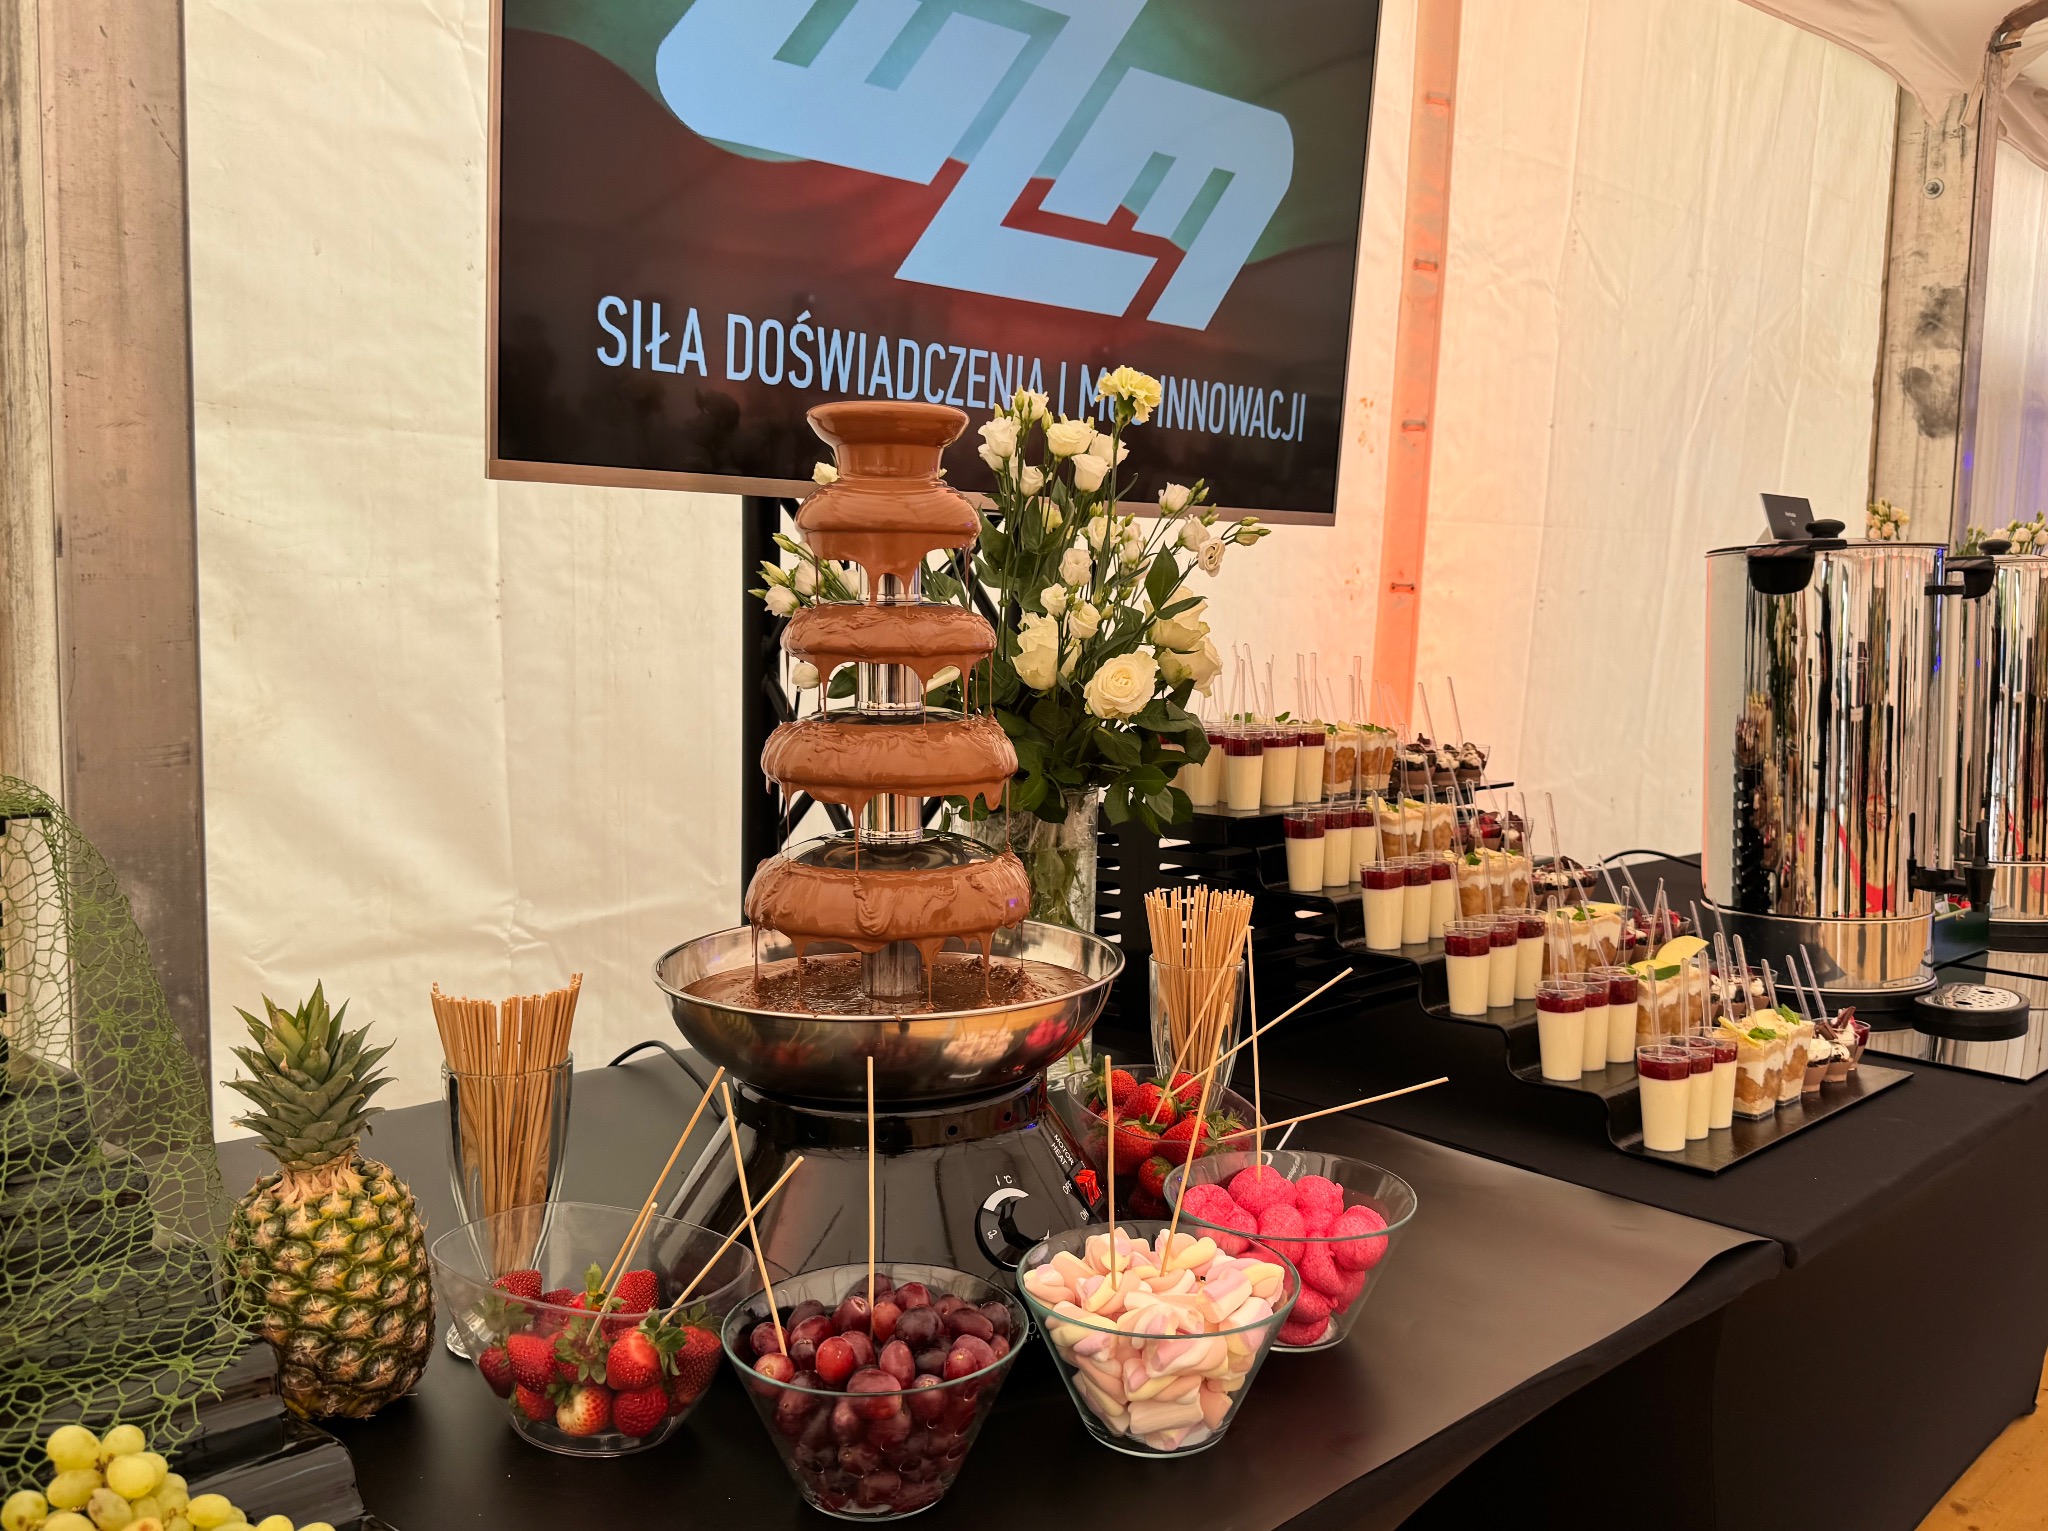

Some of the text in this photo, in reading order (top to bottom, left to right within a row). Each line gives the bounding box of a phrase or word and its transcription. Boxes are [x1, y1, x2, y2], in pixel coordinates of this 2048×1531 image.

[596, 295, 708, 377] SIŁA
[726, 309, 1044, 412] DOŚWIADCZENIA
[1156, 374, 1307, 442] INNOWACJI
[1051, 1142, 1068, 1165] HEAT
[1053, 1133, 1075, 1166] MOTOR
[1062, 1180, 1072, 1195] OFF
